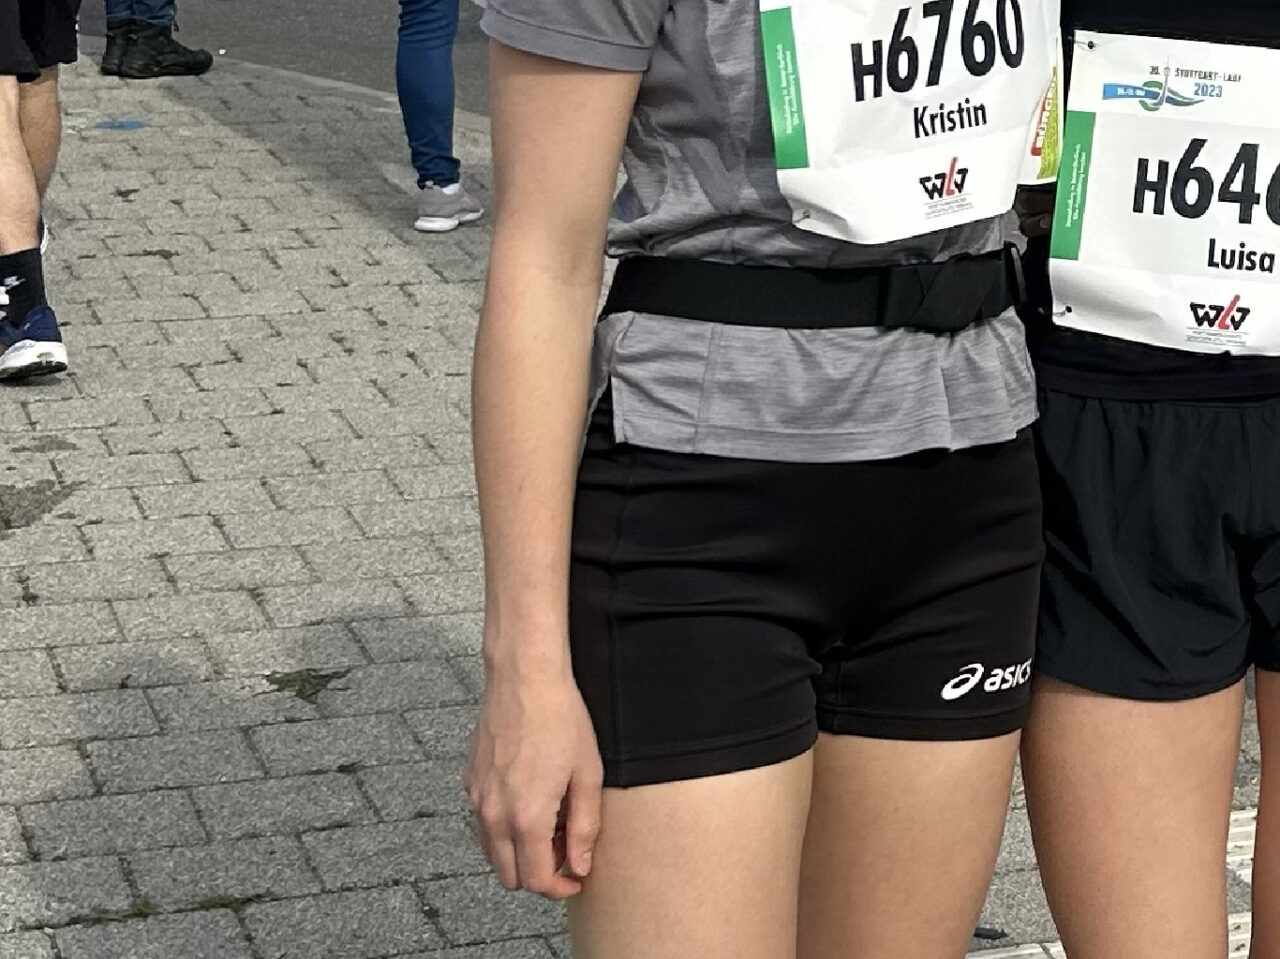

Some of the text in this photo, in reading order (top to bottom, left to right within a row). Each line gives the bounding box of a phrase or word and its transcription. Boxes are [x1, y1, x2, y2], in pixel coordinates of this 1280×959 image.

[1193, 82, 1223, 98] 2023
[913, 97, 988, 139] Kristin
[1207, 238, 1276, 274] Luisa
